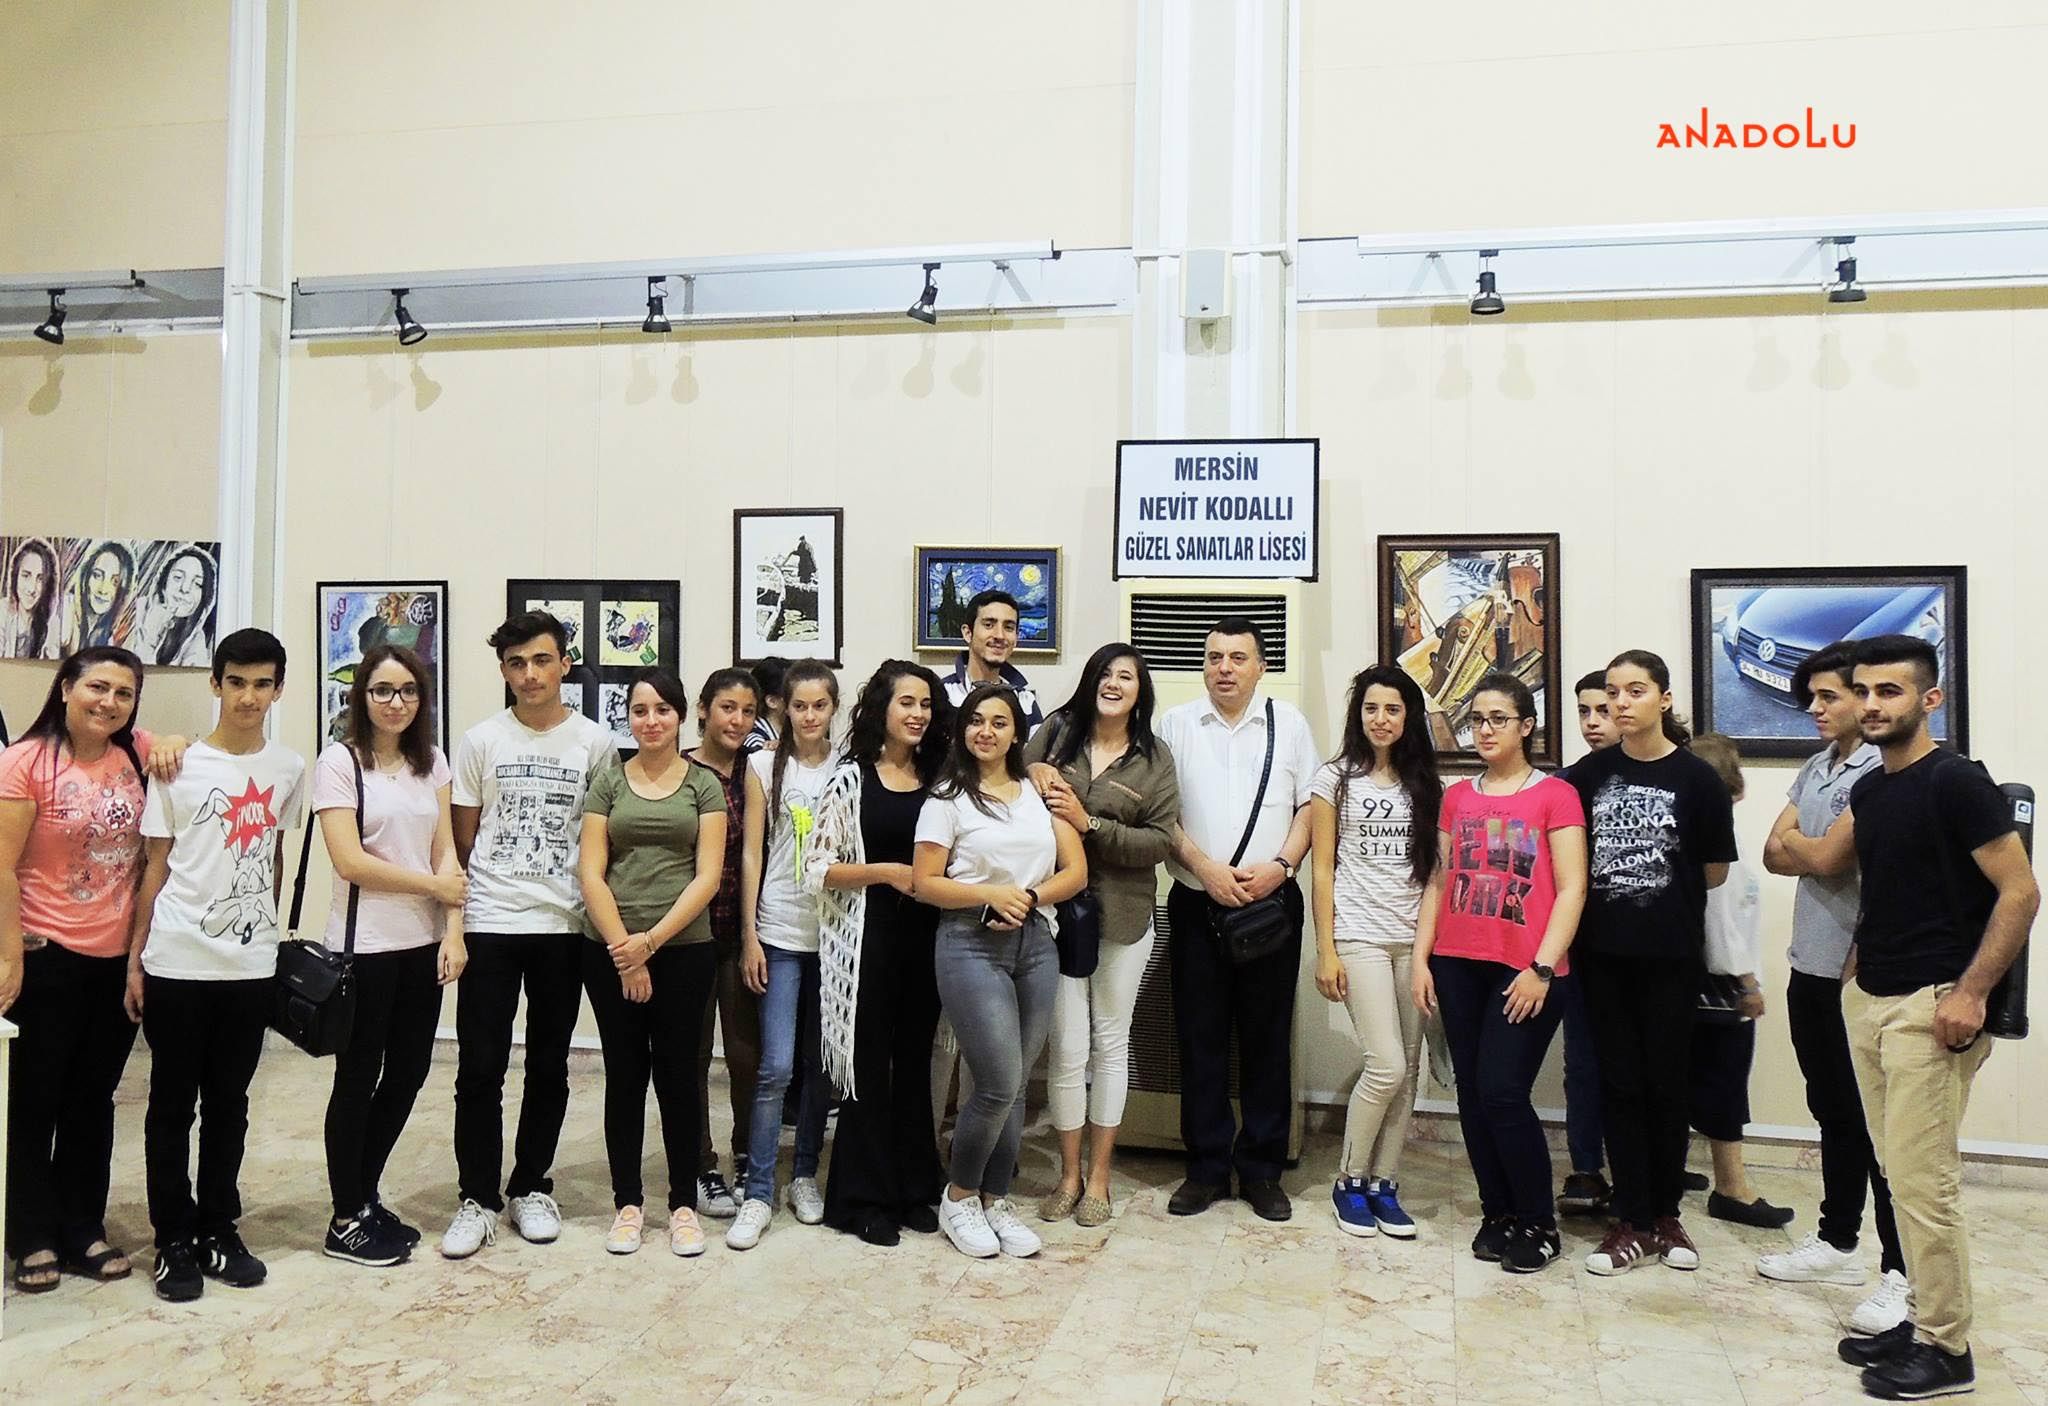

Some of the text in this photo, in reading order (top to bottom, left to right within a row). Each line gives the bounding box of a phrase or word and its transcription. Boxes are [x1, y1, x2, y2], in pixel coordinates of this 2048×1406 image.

[1175, 452, 1258, 481] MERSİN
[1139, 491, 1293, 521] NEVİT KODALLI
[1125, 531, 1306, 561] GÜZEL SANATLAR LİSESİ
[1627, 784, 1676, 801] BARCELONA
[1363, 797, 1394, 819] 99
[1359, 824, 1413, 838] SUMME
[1360, 841, 1411, 856] STYLE
